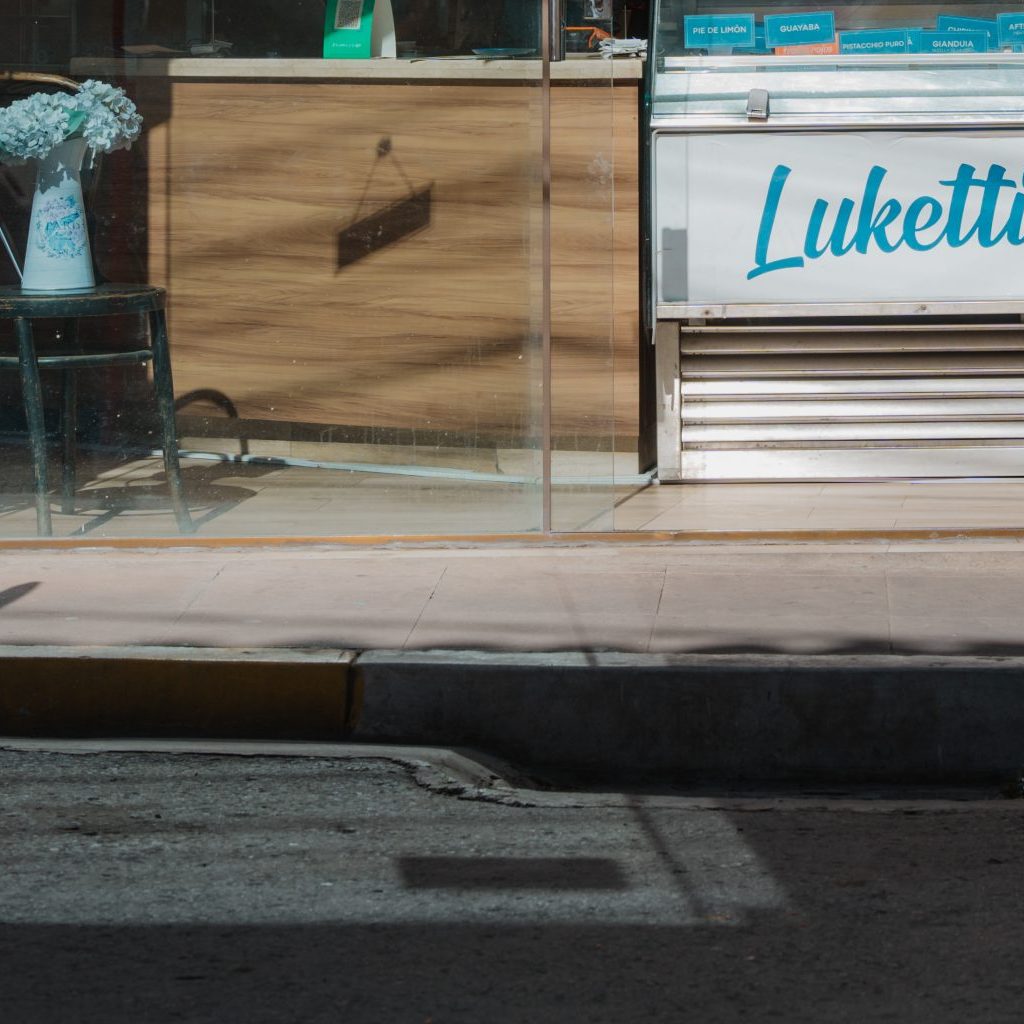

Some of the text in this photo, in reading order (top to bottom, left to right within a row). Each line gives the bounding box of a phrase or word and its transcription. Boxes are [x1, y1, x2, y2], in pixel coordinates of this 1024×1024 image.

[692, 27, 706, 35] PIE
[779, 23, 820, 33] GUAYABA
[842, 41, 885, 50] PISTACCHIO
[885, 40, 905, 48] PURO
[932, 40, 974, 48] GIANDUIA
